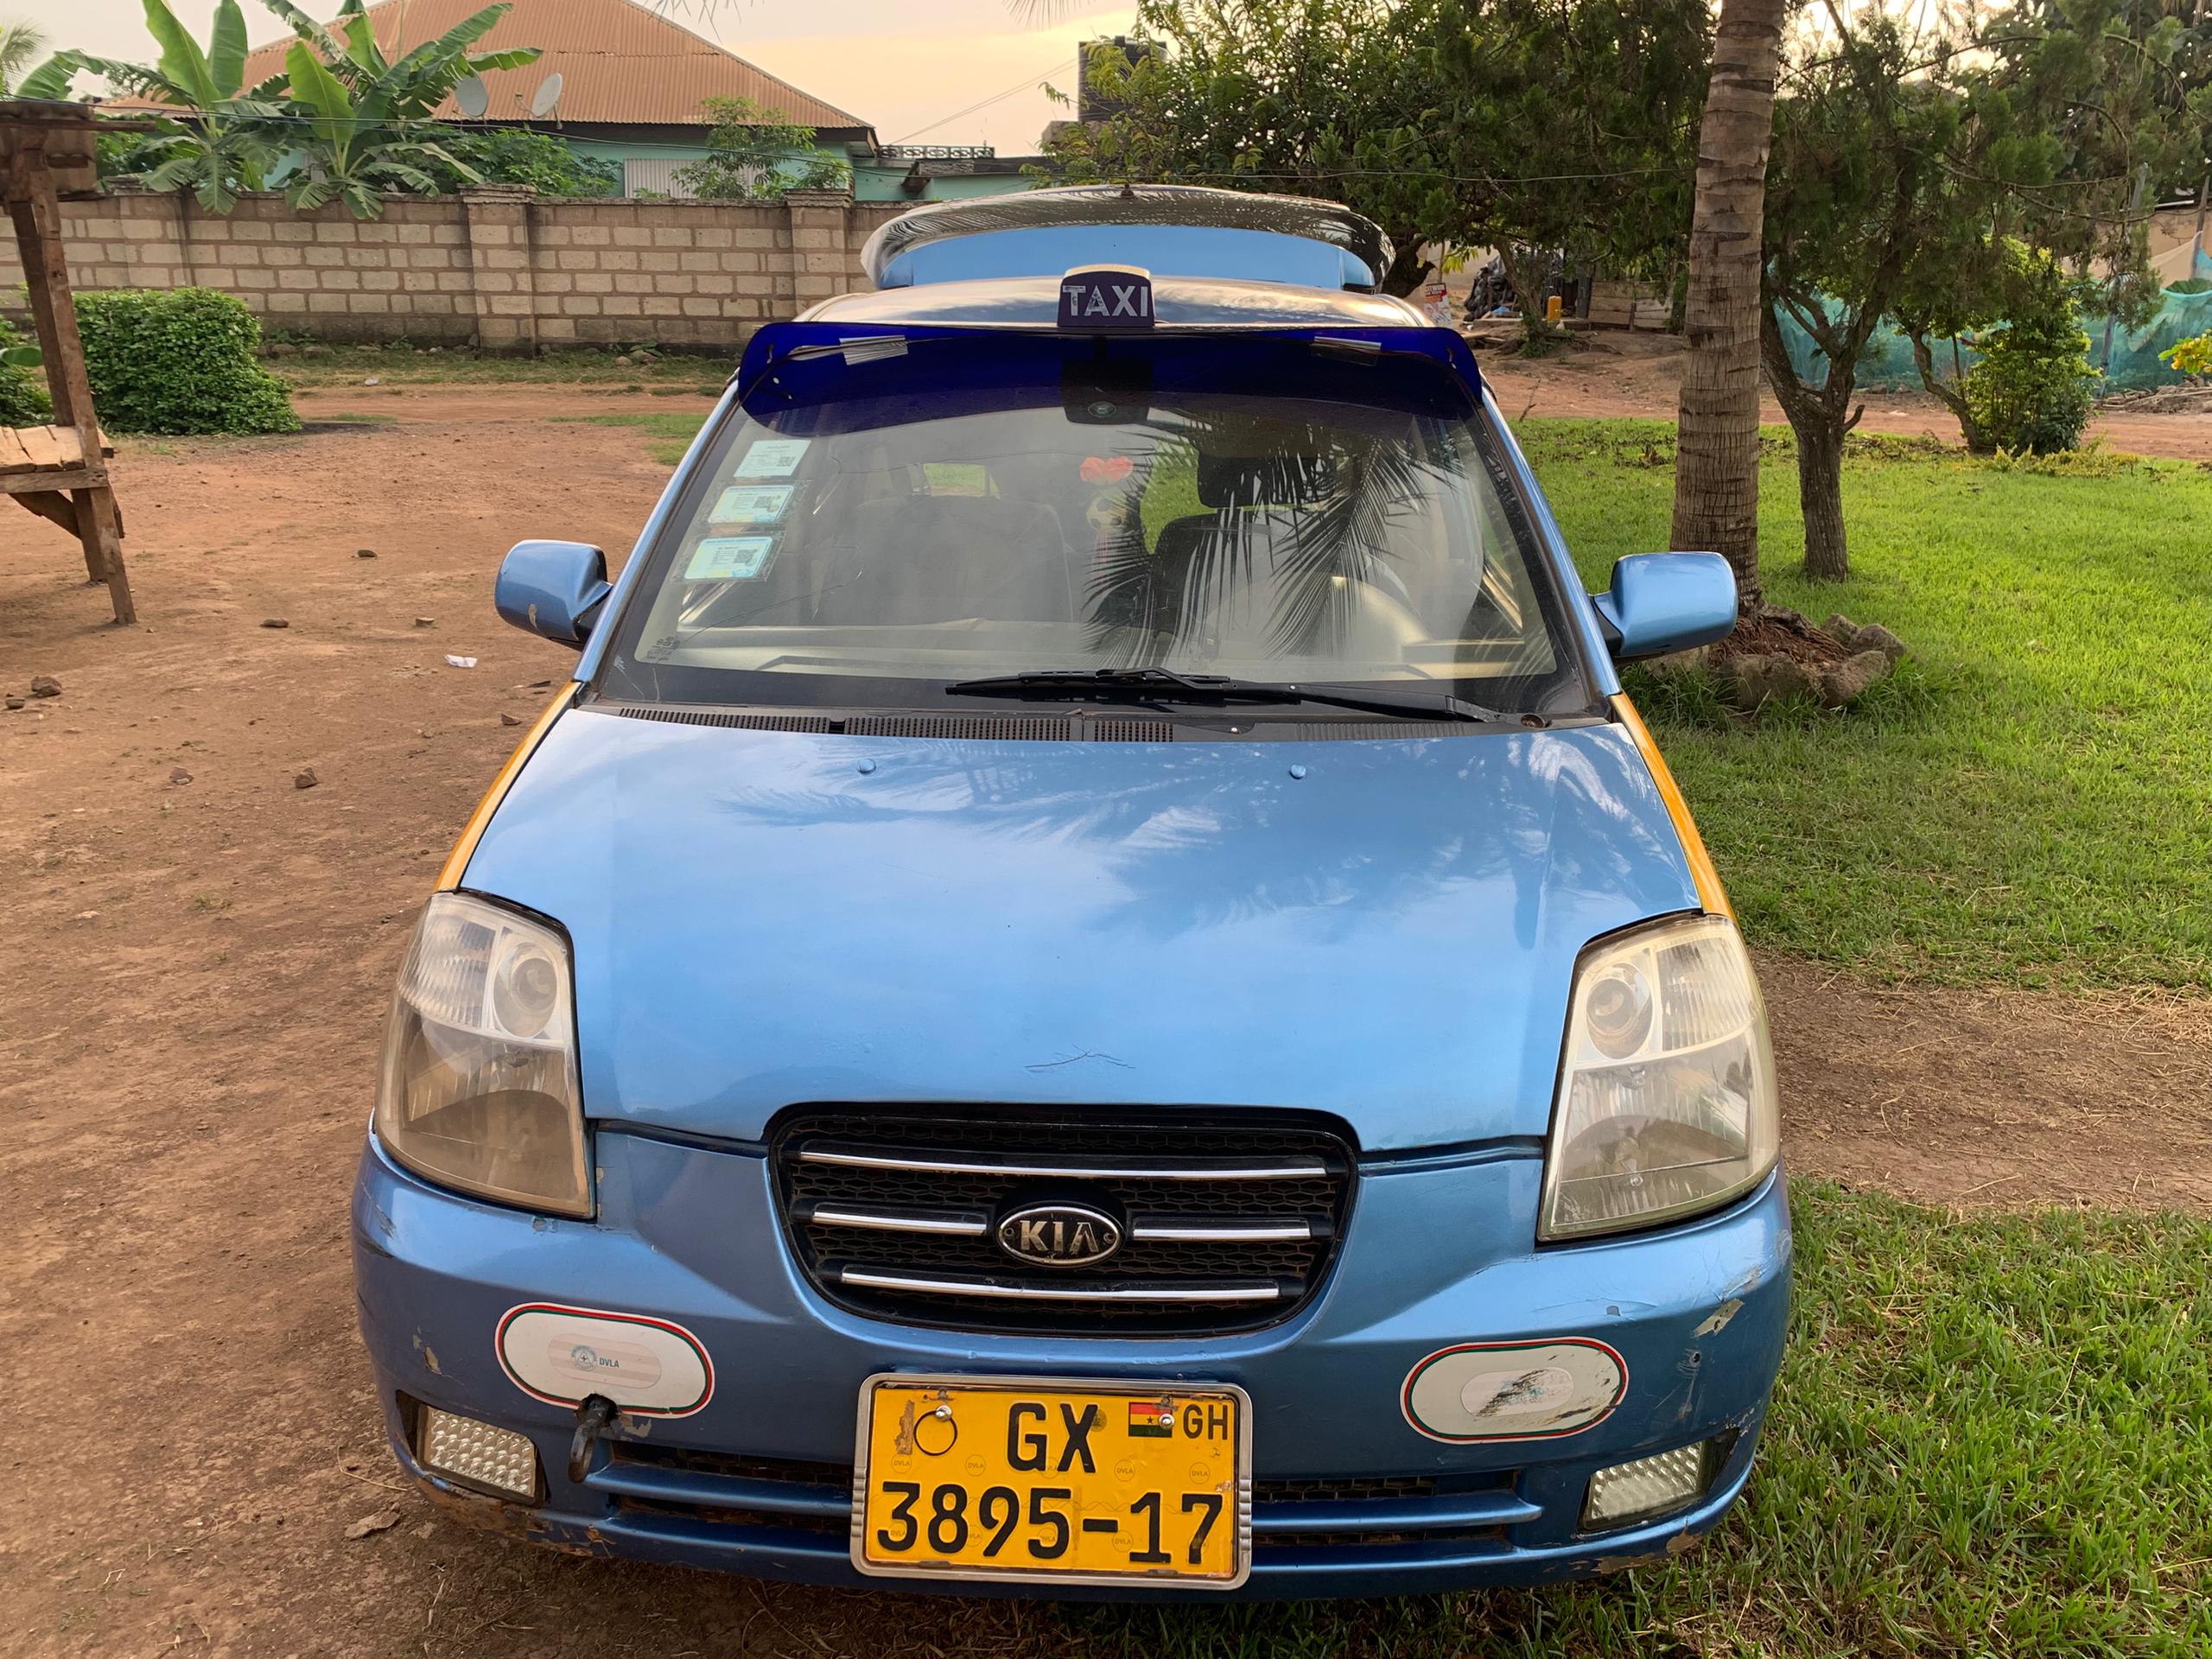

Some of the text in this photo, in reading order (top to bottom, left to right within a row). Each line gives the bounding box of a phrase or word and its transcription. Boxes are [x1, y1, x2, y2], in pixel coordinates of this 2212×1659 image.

[1062, 285, 1148, 317] TAXI
[1020, 1220, 1099, 1253] KIA
[599, 1357, 620, 1368] DVLA
[1007, 1402, 1098, 1473] GX
[1183, 1404, 1228, 1440] GH
[877, 1481, 1223, 1564] 3895-17
